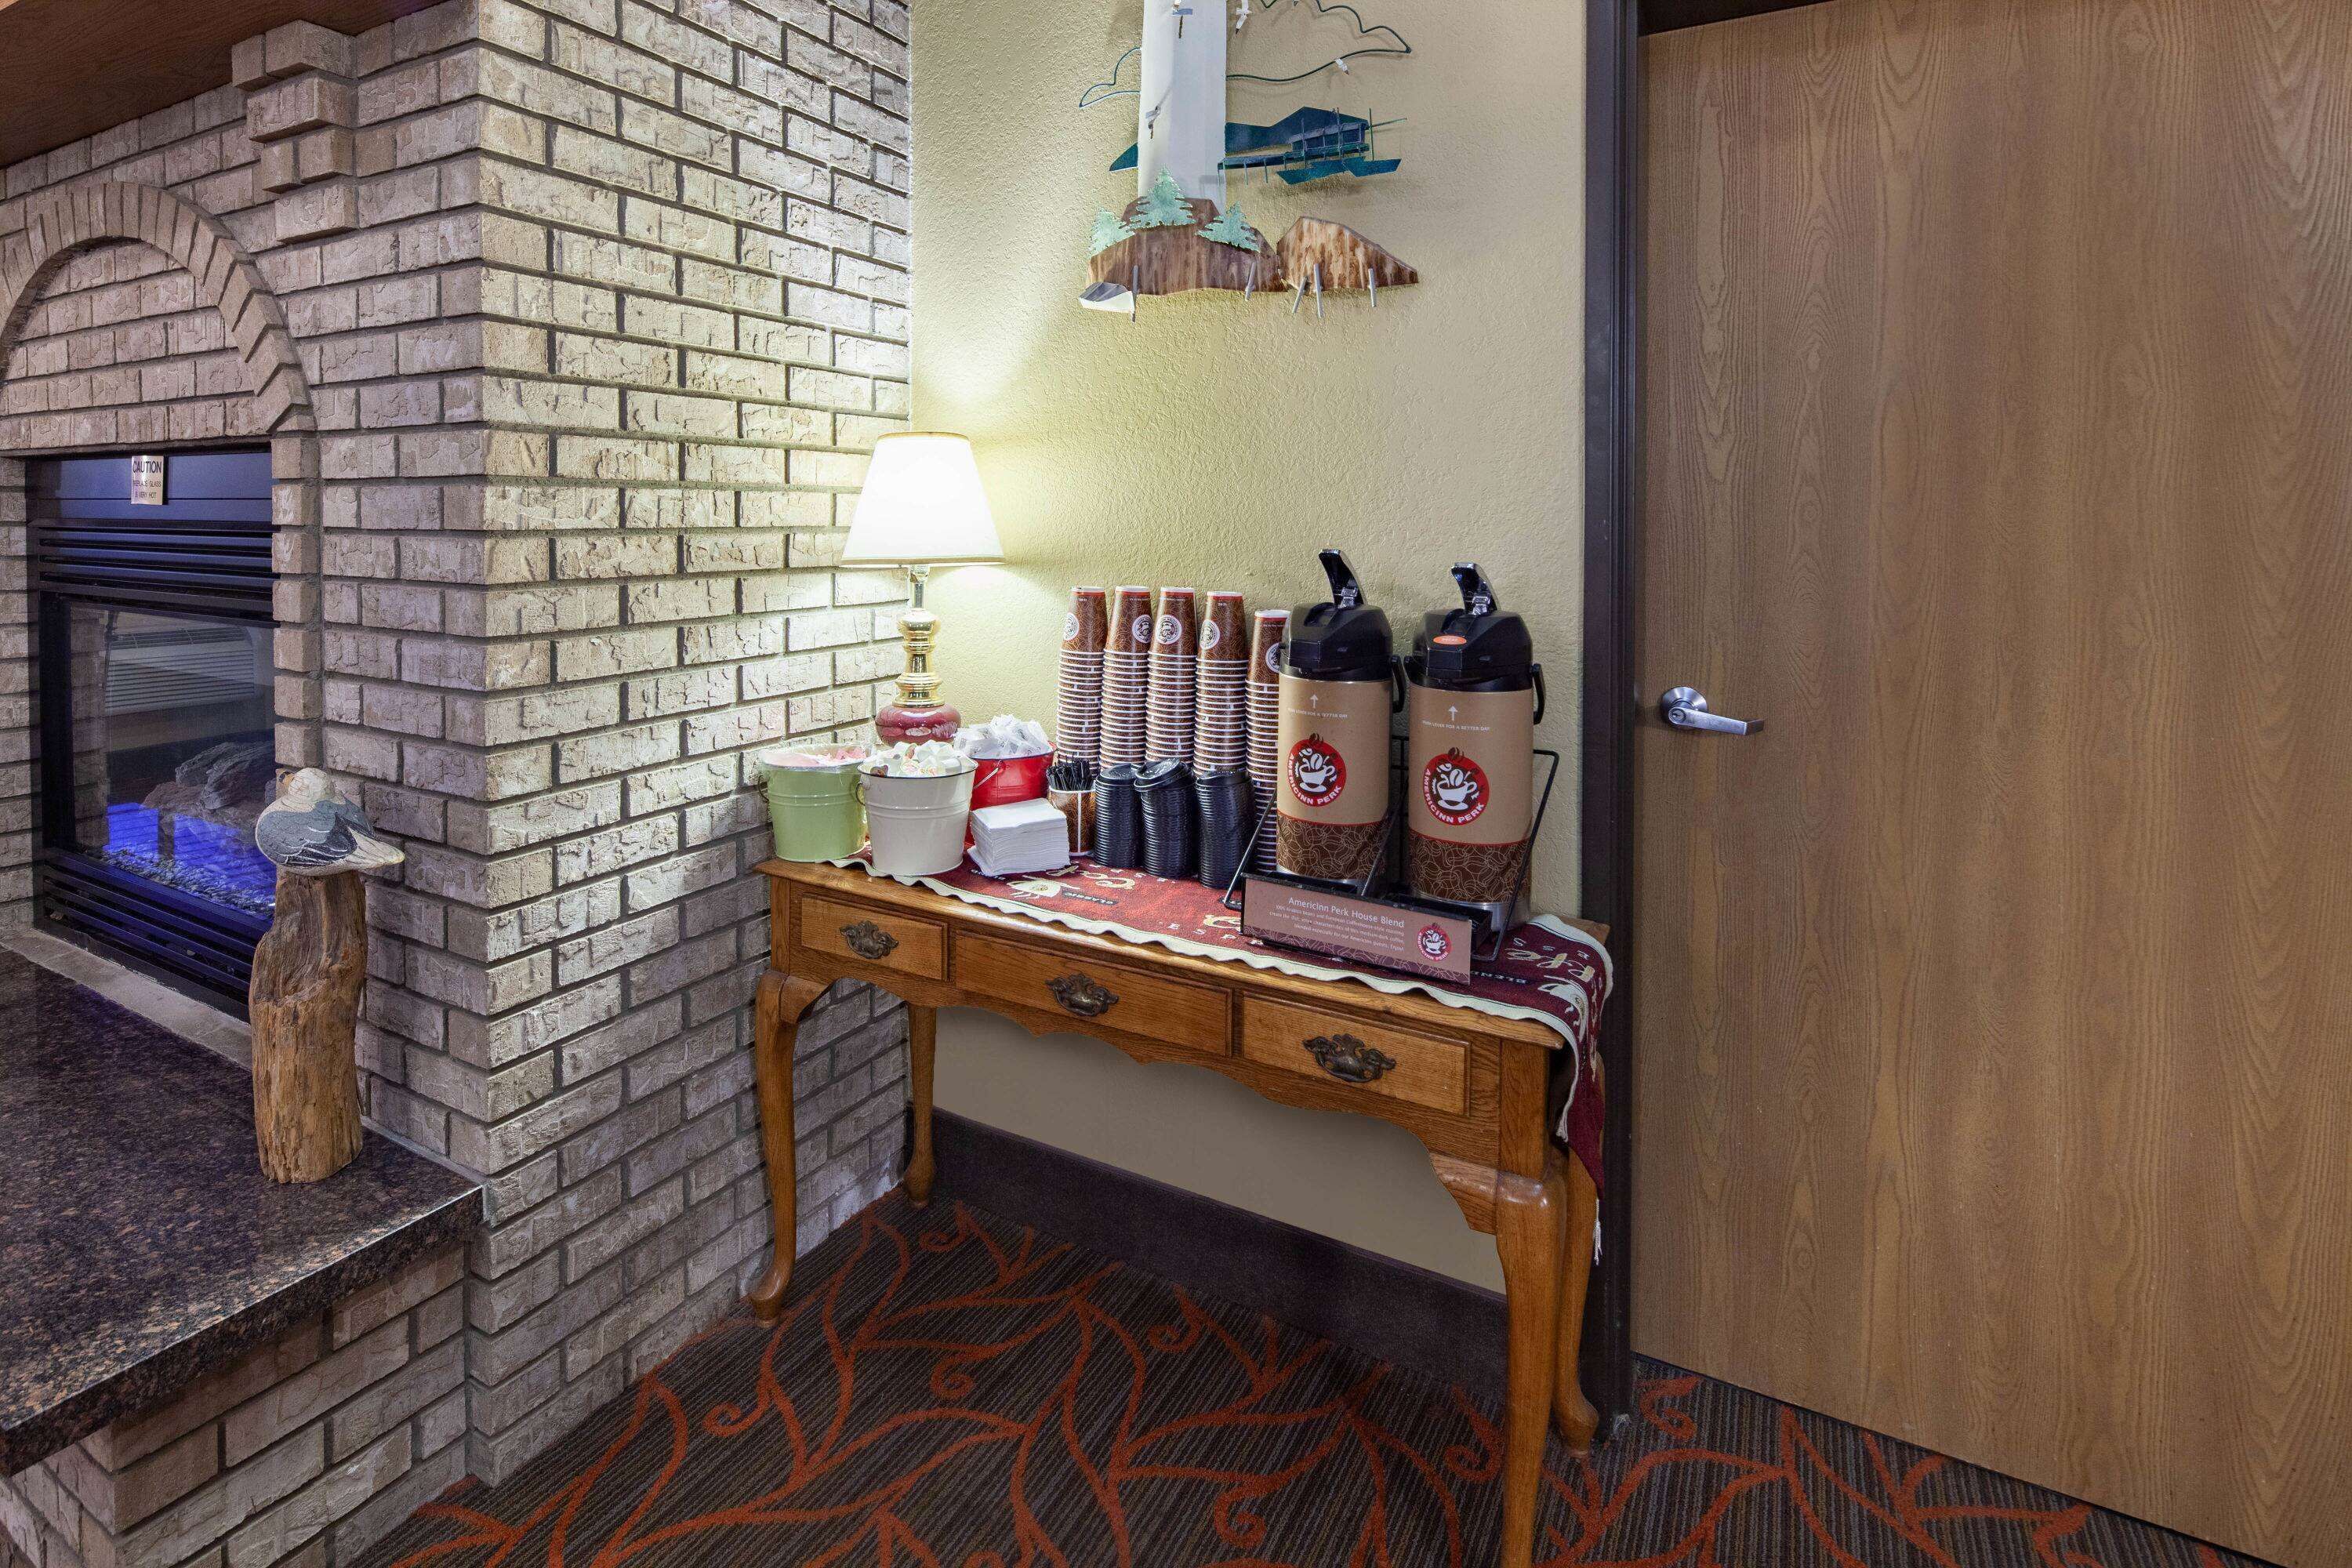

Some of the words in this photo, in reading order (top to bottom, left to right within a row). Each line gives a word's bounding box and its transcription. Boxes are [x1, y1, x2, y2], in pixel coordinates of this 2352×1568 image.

[132, 461, 162, 474] CAUTION
[1288, 753, 1313, 804] AMERICINN
[1317, 785, 1341, 804] PERK
[1424, 768, 1454, 823] AMERICINN
[1458, 802, 1485, 823] PERK
[1064, 891, 1114, 905] CLASSIC
[1289, 897, 1328, 912] AmericInn
[1331, 906, 1348, 916] Perk
[1352, 910, 1377, 923] House
[1381, 916, 1404, 928] Blend
